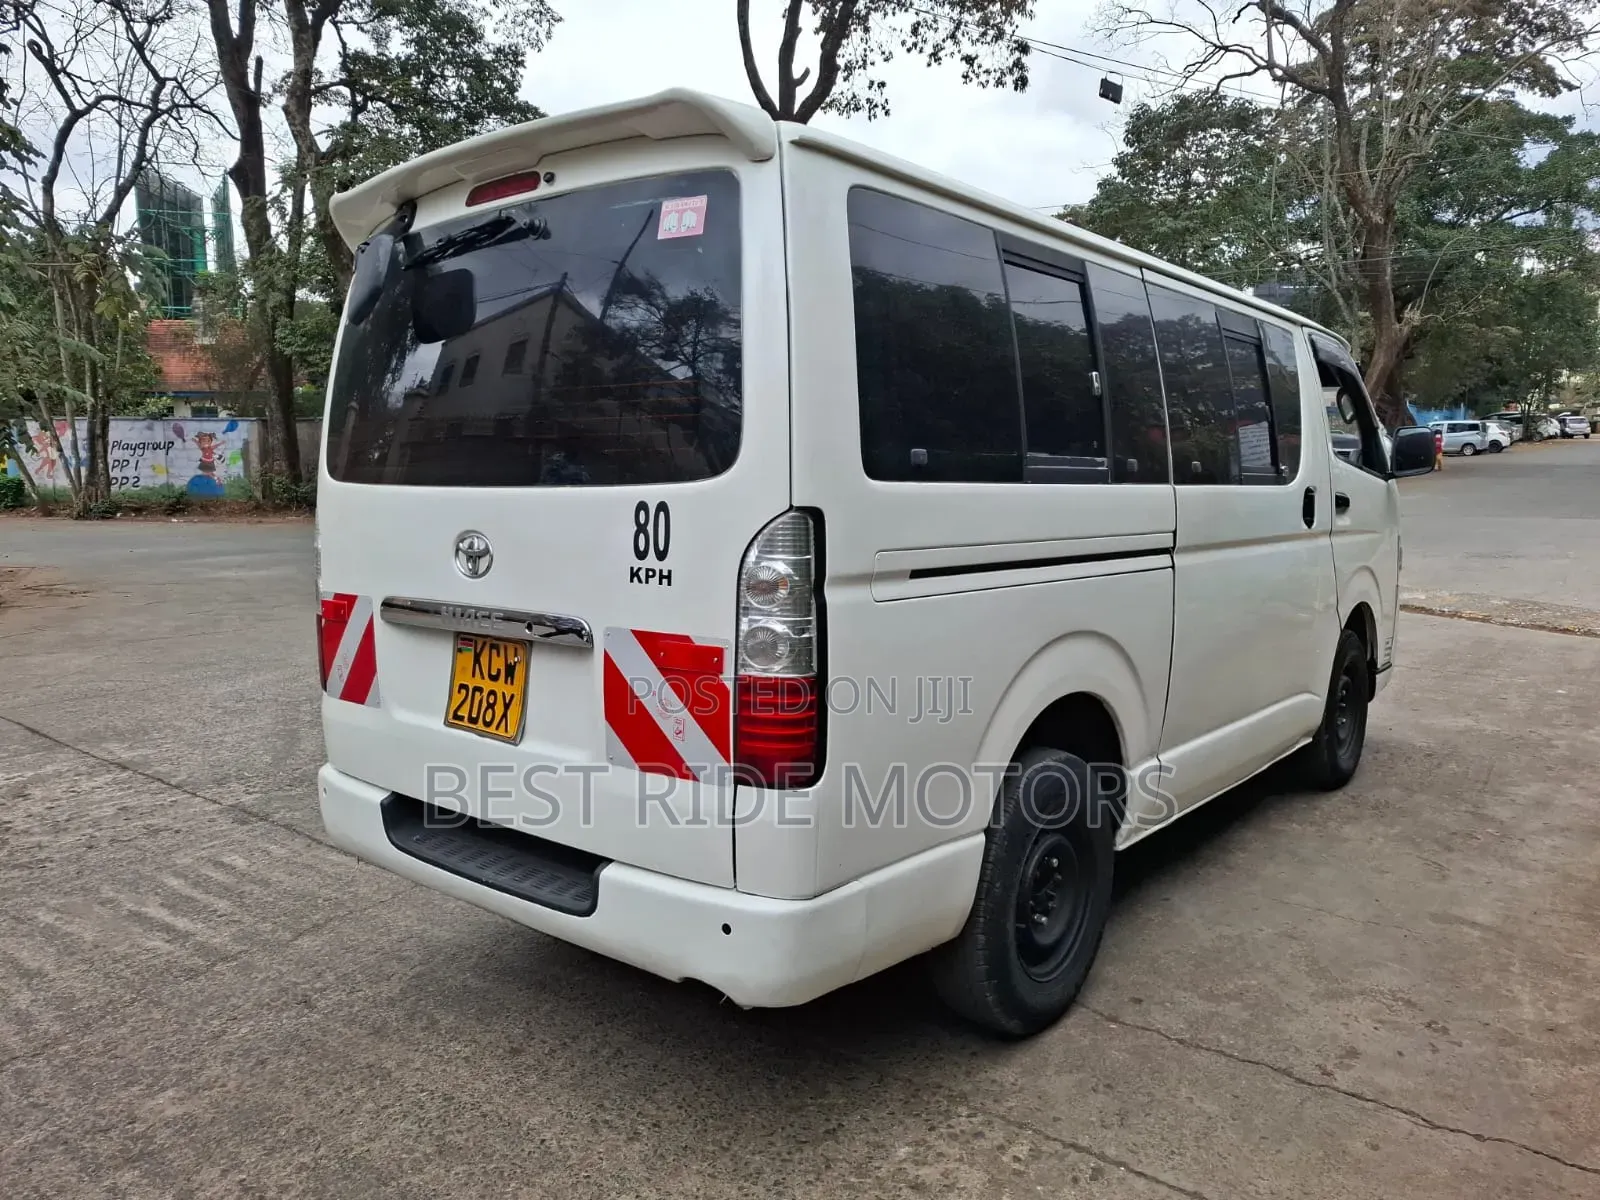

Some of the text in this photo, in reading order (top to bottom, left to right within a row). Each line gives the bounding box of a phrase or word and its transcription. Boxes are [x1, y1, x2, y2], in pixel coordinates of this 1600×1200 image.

[110, 440, 175, 457] Playgroup
[111, 459, 130, 472] PP
[110, 475, 140, 491] PP 2
[633, 500, 671, 562] 80
[629, 566, 672, 587] KPH
[471, 638, 519, 686] KCW
[452, 683, 516, 733] 208X
